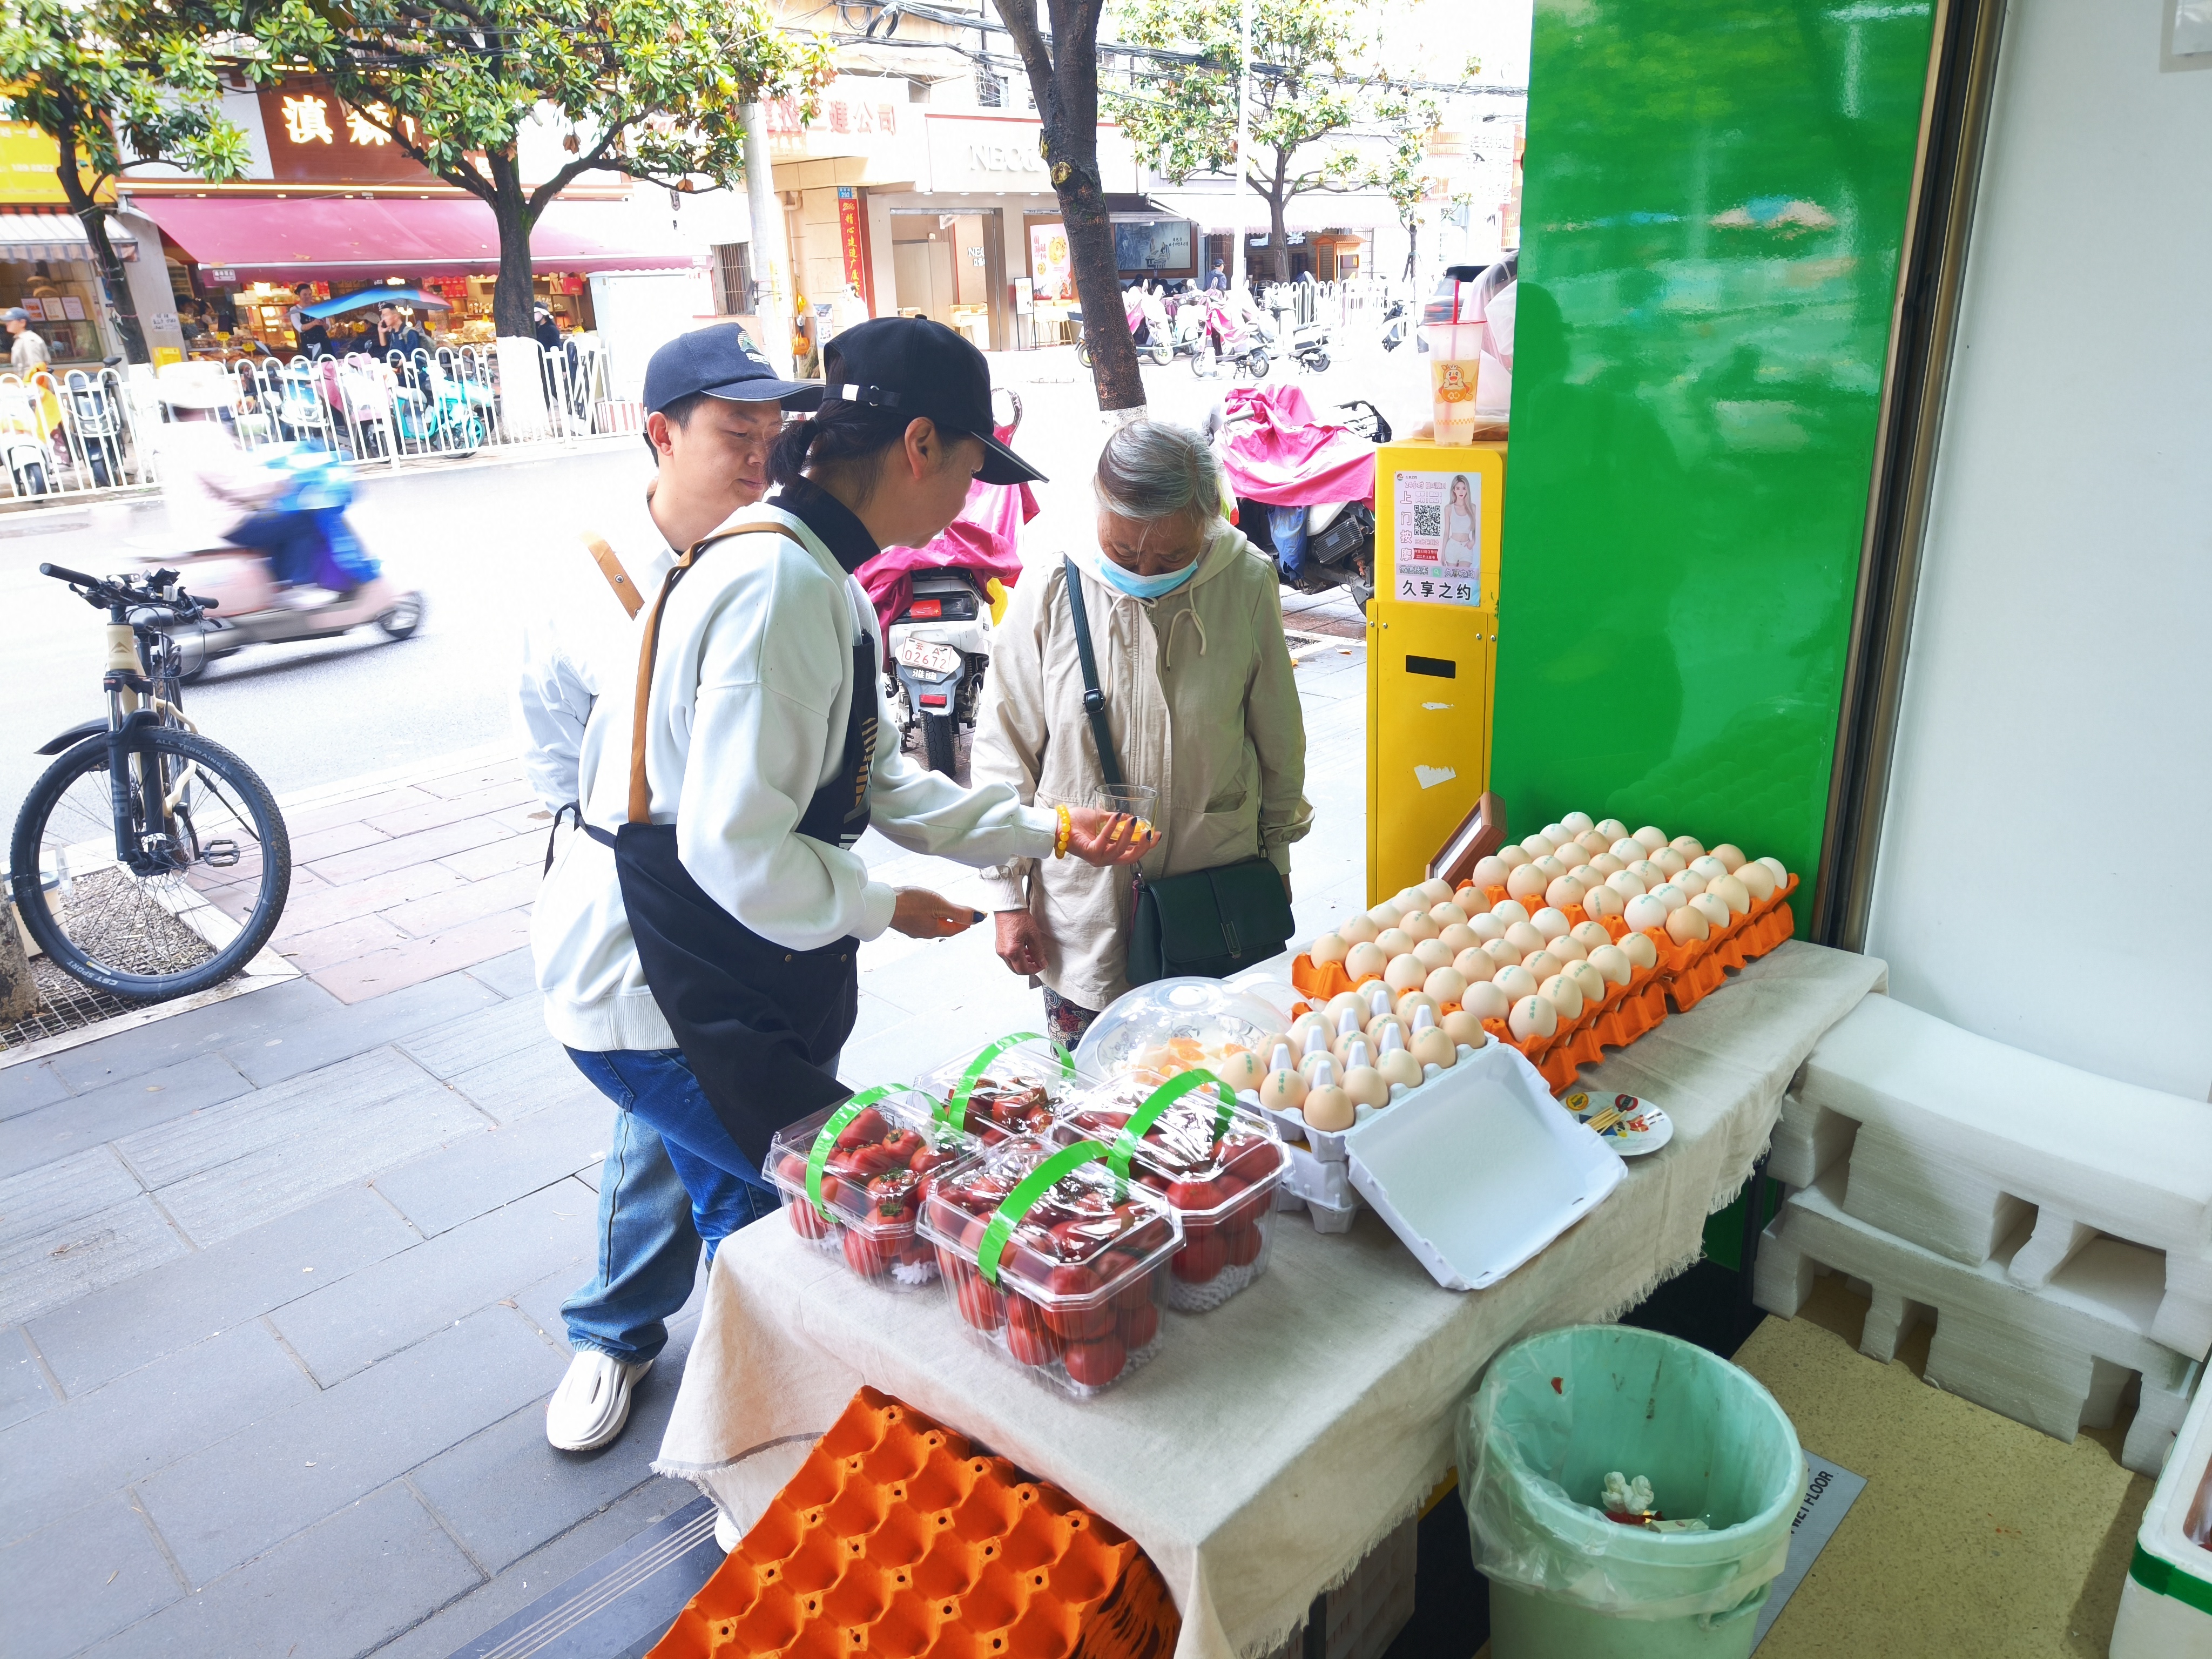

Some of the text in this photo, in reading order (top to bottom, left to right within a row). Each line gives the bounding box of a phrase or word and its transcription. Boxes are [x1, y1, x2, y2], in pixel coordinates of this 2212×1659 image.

[1400, 490, 1412, 562] 上门按摩
[1399, 565, 1475, 579] 微信搜索 久享之约
[1402, 579, 1471, 601] 久享之约
[905, 650, 946, 670] 02672
[912, 669, 938, 681] 雅迪
[111, 778, 129, 818] AIR
[66, 961, 119, 986] CST SPORT
[1803, 1471, 1834, 1506] FLOOR
